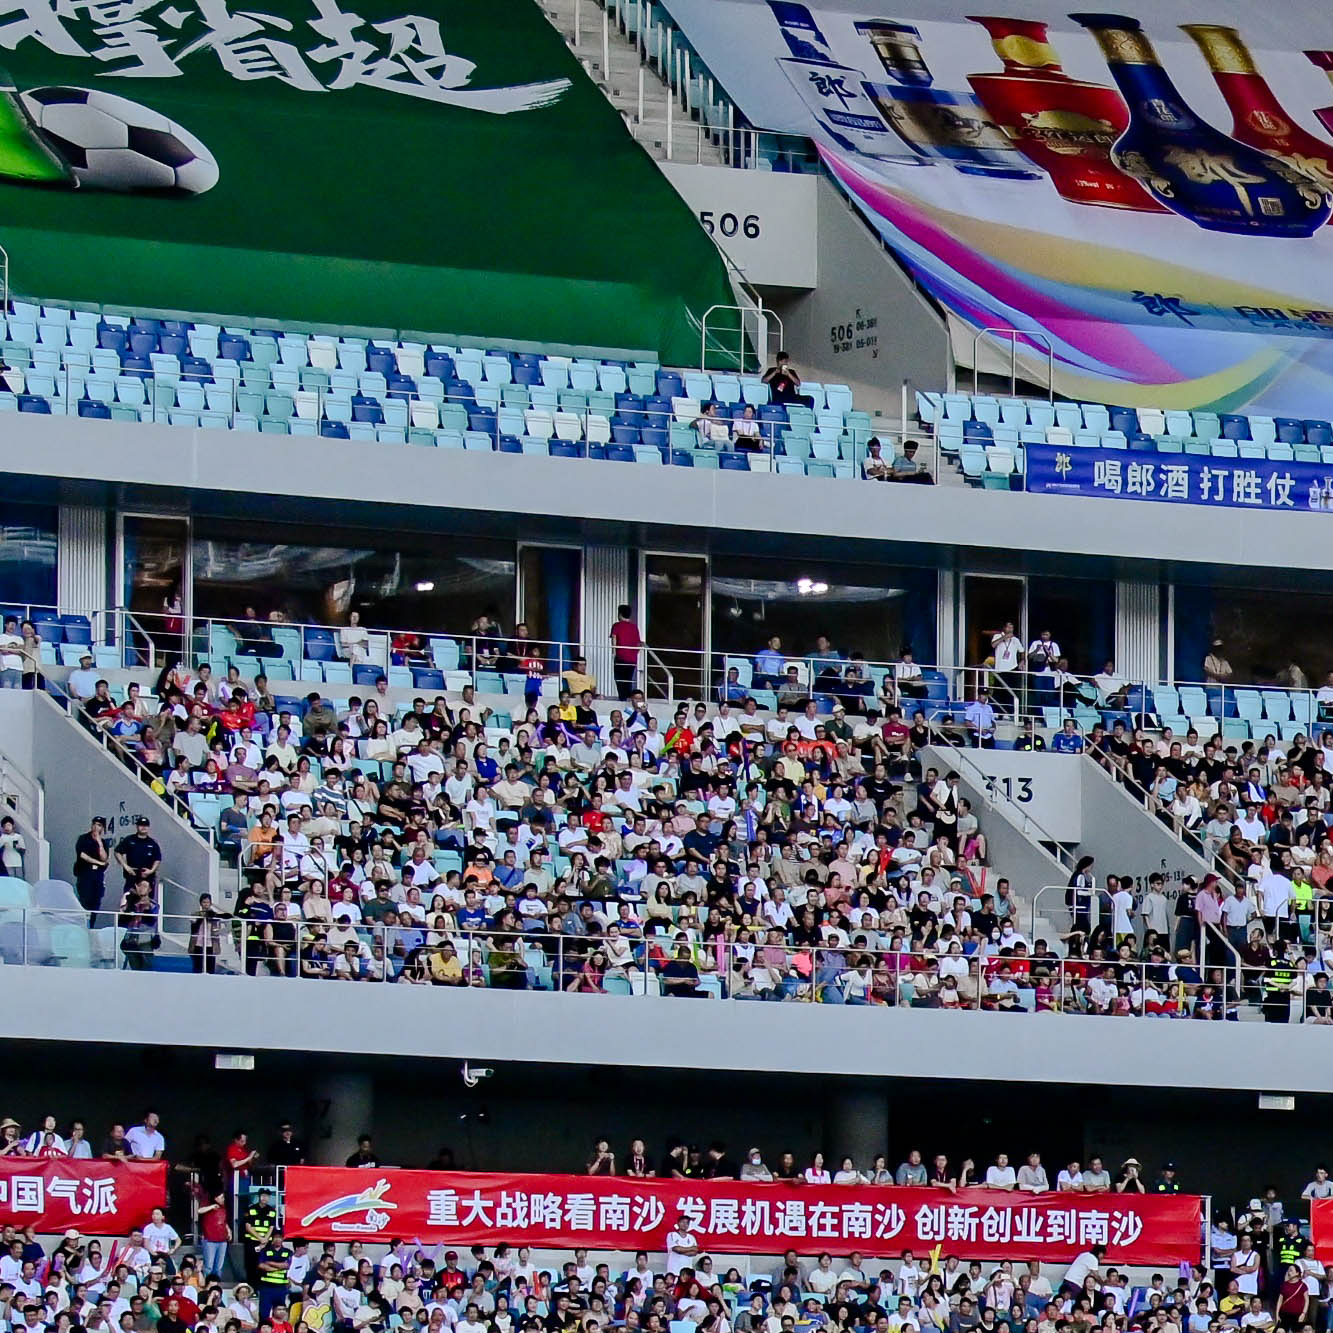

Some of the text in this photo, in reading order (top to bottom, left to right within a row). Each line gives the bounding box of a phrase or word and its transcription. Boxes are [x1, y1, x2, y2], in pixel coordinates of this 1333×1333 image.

[700, 212, 760, 239] 506
[831, 323, 853, 342] 506
[1093, 459, 1296, 507] 喝郎酒 打胜仗
[982, 776, 1033, 803] 313
[0, 1175, 118, 1215] 国气派
[426, 1188, 1144, 1248] 重大战略看南沙 发展机遇在南沙 创新创业到南沙
